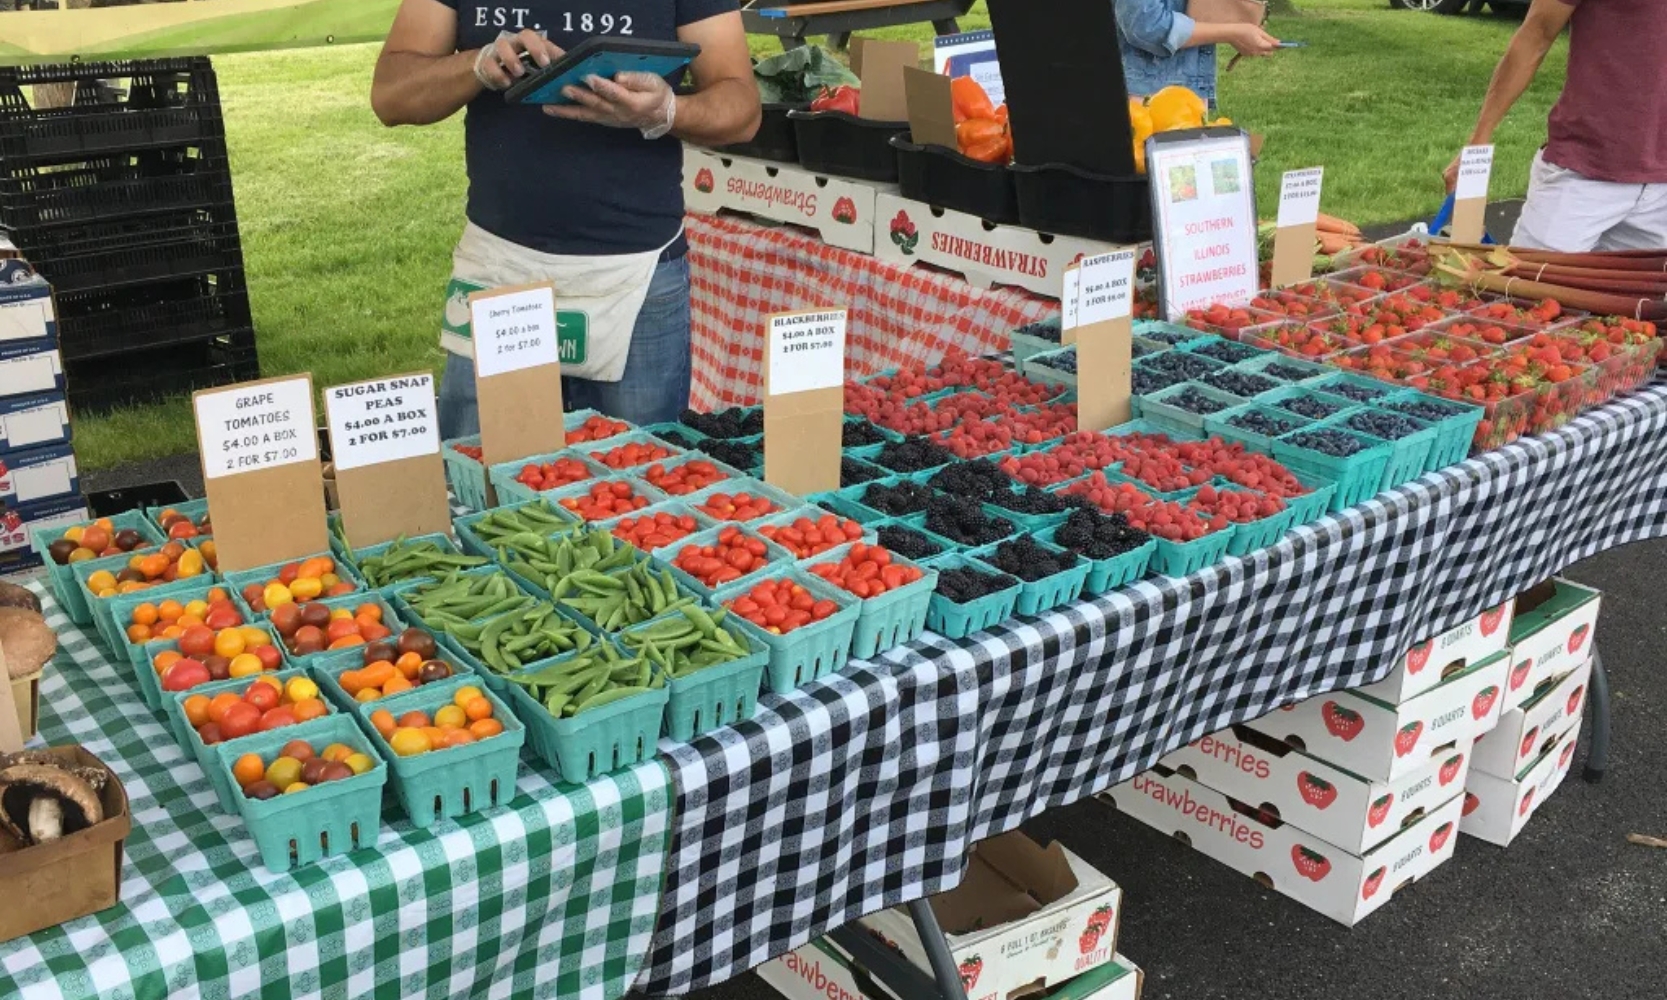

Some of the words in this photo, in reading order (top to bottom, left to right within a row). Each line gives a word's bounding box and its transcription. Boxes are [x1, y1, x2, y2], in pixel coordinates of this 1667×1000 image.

[474, 6, 541, 30] EST.
[562, 12, 634, 36] 1892
[726, 176, 818, 217] Strawberries
[1184, 216, 1234, 236] SOUTHERN
[931, 230, 1048, 278] STRAWBERRIES
[1083, 251, 1134, 267] RASPBERRIES
[1194, 243, 1230, 260] ILLINOIS
[1112, 278, 1127, 288] BOX
[1180, 264, 1246, 288] STRAWBERRIES
[489, 308, 510, 318] Cherry
[512, 303, 543, 314] Tomatoes
[1091, 295, 1106, 306] FOR
[774, 312, 845, 327] BLACKBERRIES
[496, 327, 519, 339] $4.00
[527, 324, 540, 332] box
[782, 330, 805, 340] $4.00
[815, 326, 836, 336] BOX
[498, 346, 502, 354] 2
[504, 343, 515, 352] for
[518, 338, 541, 350] $7.00
[790, 342, 808, 352] FOR
[810, 340, 833, 350] $7.00
[335, 382, 386, 398] SUGAR
[390, 376, 430, 391] SNAP
[236, 393, 274, 409] GRAPE
[366, 396, 403, 410] PEAS
[224, 410, 290, 431] TOMATOES
[345, 417, 380, 431] $4.00
[384, 414, 394, 424] A
[398, 409, 427, 422] BOX
[222, 435, 258, 452] $4.00
[263, 434, 271, 444] A
[275, 429, 297, 441] BOX
[349, 438, 356, 446] 2
[360, 431, 389, 444] FOR
[392, 426, 427, 440] $7.00
[226, 459, 233, 469] 2
[239, 454, 260, 467] FOR
[264, 448, 297, 463] $7.00
[1447, 624, 1472, 646] QUARTS
[1437, 705, 1466, 727] QUARTS
[1189, 735, 1271, 778] erries
[1132, 774, 1264, 850] trawberries
[1008, 938, 1022, 952] FULL
[1074, 948, 1108, 972] QUALITY
[780, 952, 864, 1000] awber
